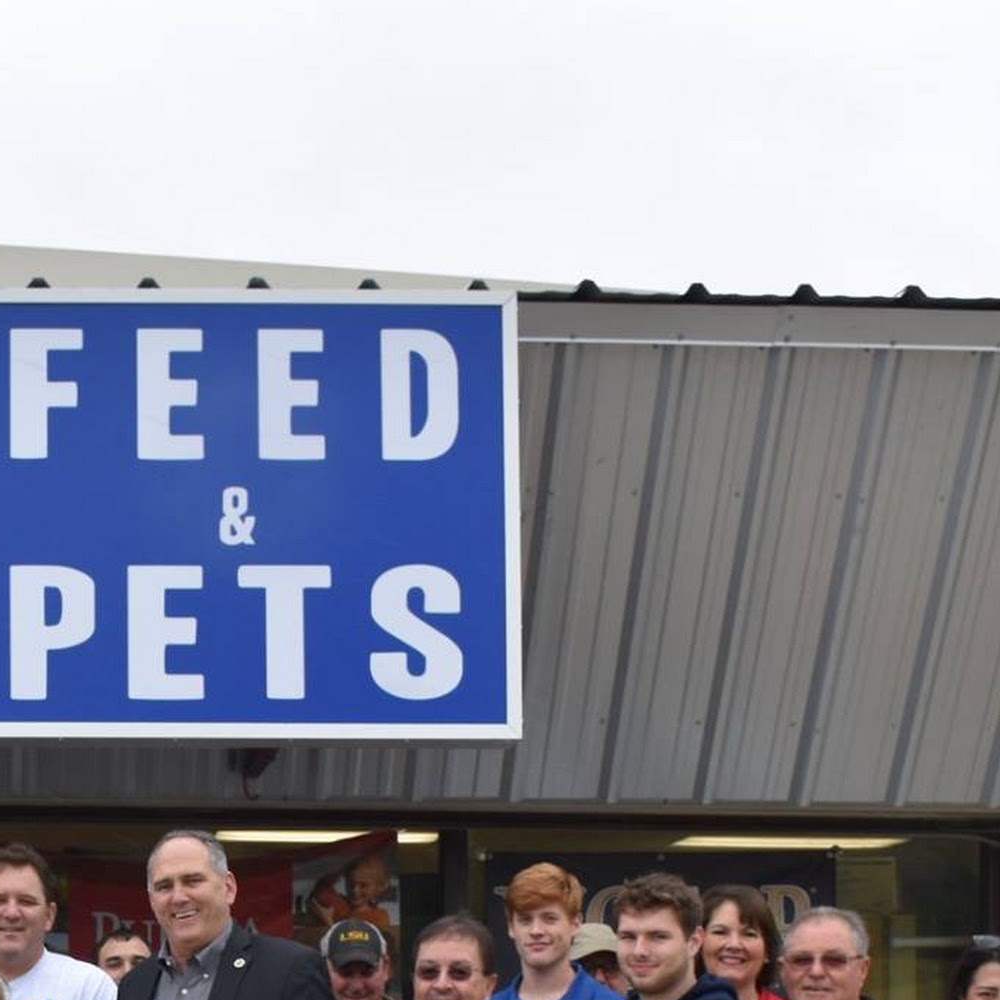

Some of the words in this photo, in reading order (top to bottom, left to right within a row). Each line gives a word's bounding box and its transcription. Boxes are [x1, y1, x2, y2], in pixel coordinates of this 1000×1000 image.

[10, 328, 459, 461] FEED
[219, 486, 256, 546] &
[9, 564, 464, 701] PETS
